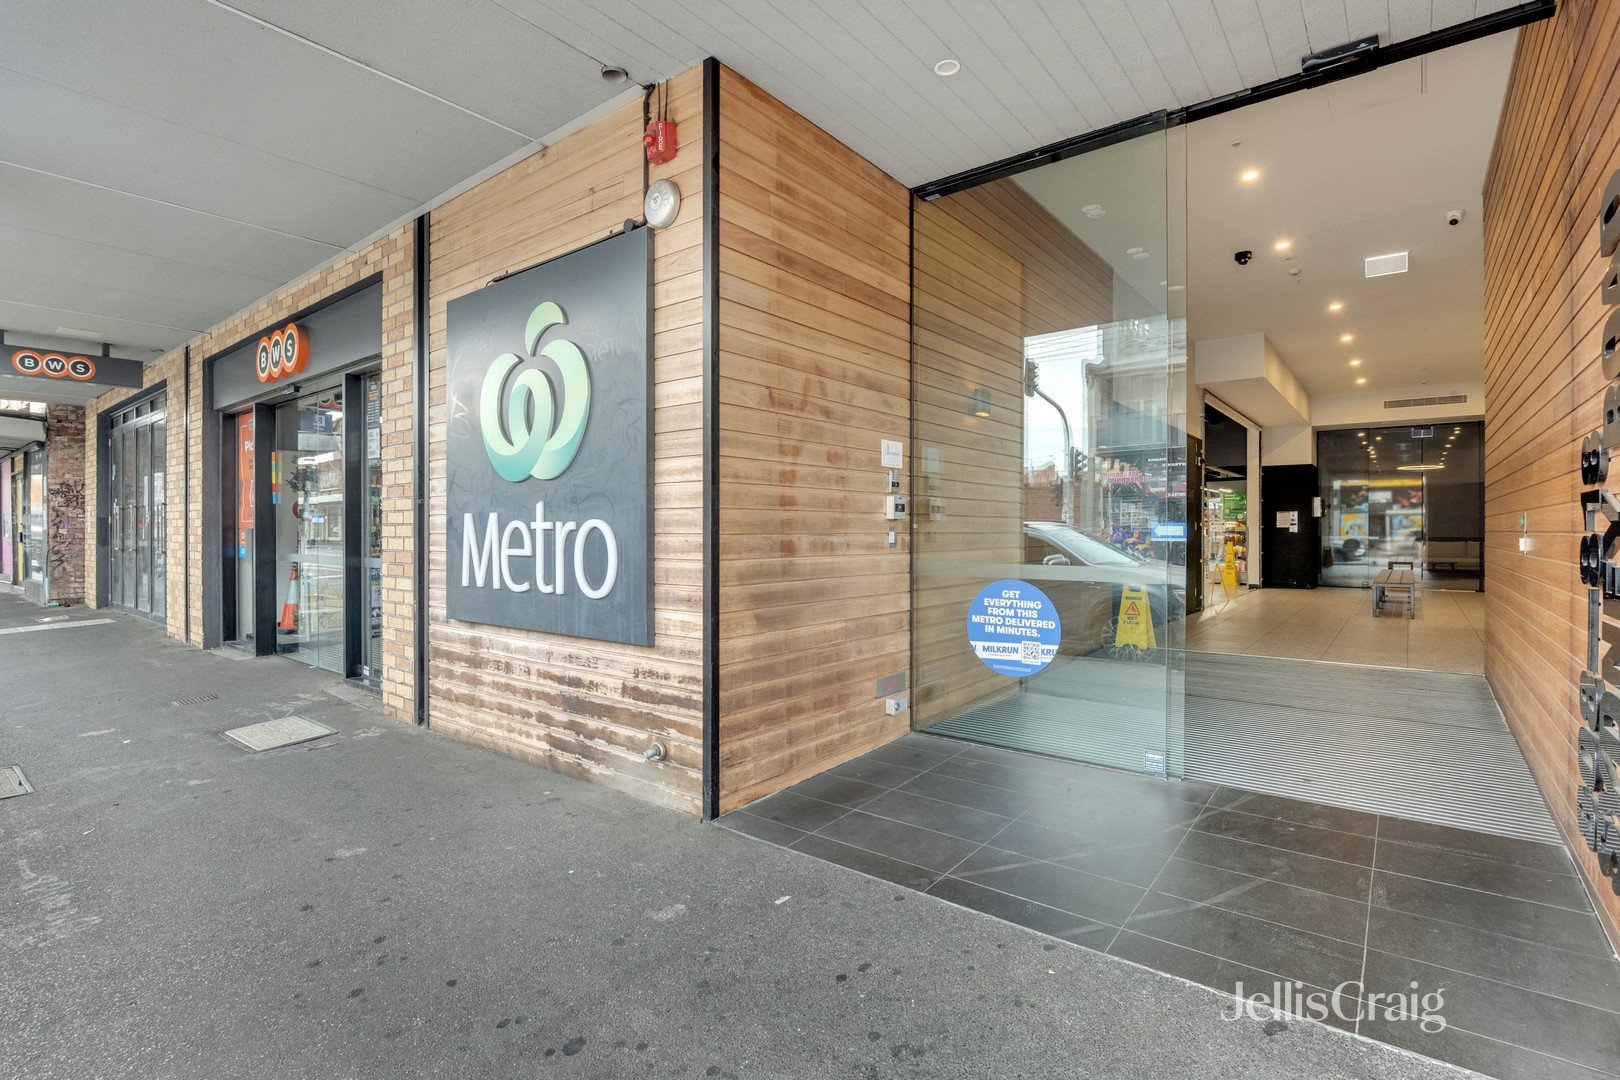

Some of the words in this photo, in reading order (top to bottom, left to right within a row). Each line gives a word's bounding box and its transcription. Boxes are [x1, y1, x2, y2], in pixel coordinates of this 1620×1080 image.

[260, 339, 294, 368] BWS
[24, 357, 86, 373] BWS
[461, 500, 618, 600] Metro
[1002, 590, 1020, 599] GET
[983, 598, 1042, 610] EVERYTHING
[987, 607, 1015, 617] FROM
[1016, 609, 1038, 618] THIS
[972, 615, 1003, 625] METRO
[1005, 617, 1056, 630] DELIVERED
[984, 625, 995, 633] IN
[996, 625, 1041, 638] MINUTES.
[982, 645, 1019, 655] MILKRUN
